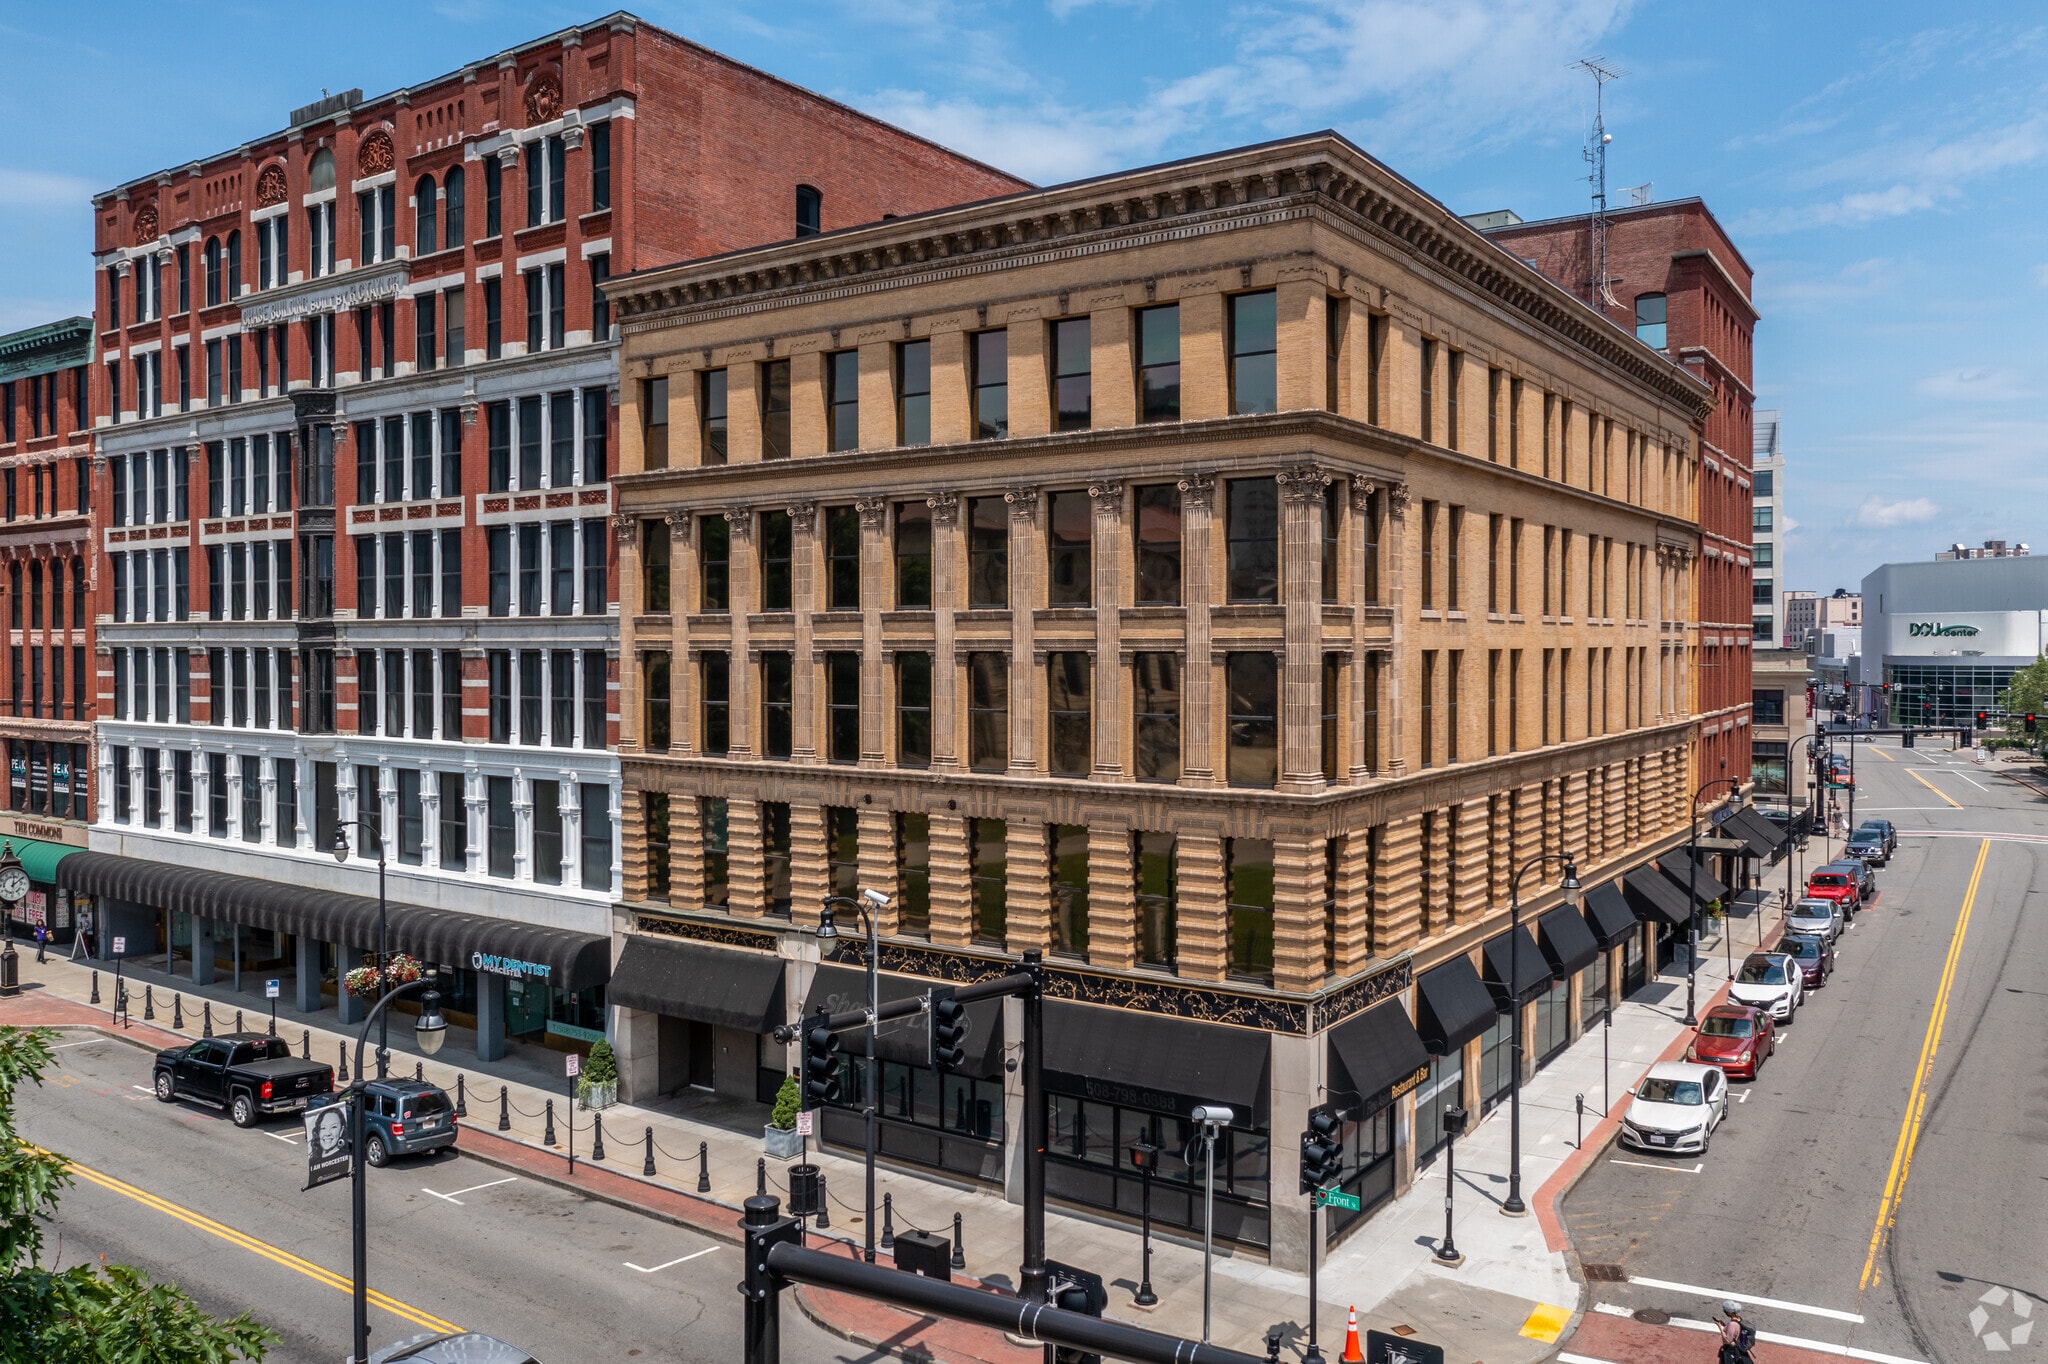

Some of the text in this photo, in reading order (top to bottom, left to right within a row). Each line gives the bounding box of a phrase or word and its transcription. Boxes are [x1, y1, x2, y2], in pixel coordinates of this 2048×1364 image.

[242, 304, 269, 327] CHASE
[271, 296, 309, 321] BUILDING
[311, 291, 335, 312] BUILT
[336, 287, 349, 306] BY
[364, 274, 400, 300] TAYLOR
[1909, 622, 1978, 637] DCU center
[14, 821, 63, 839] THE COMMONS
[28, 908, 44, 921] FREE
[483, 953, 552, 978] MY DENTIST
[483, 963, 523, 979] WORCESTER
[1391, 1074, 1416, 1100] Restaurant
[1415, 1070, 1420, 1084] &
[1420, 1067, 1429, 1081] Bar
[313, 1163, 321, 1171] AM
[321, 1154, 349, 1168] WORCESTER
[1328, 1192, 1350, 1207] Front
